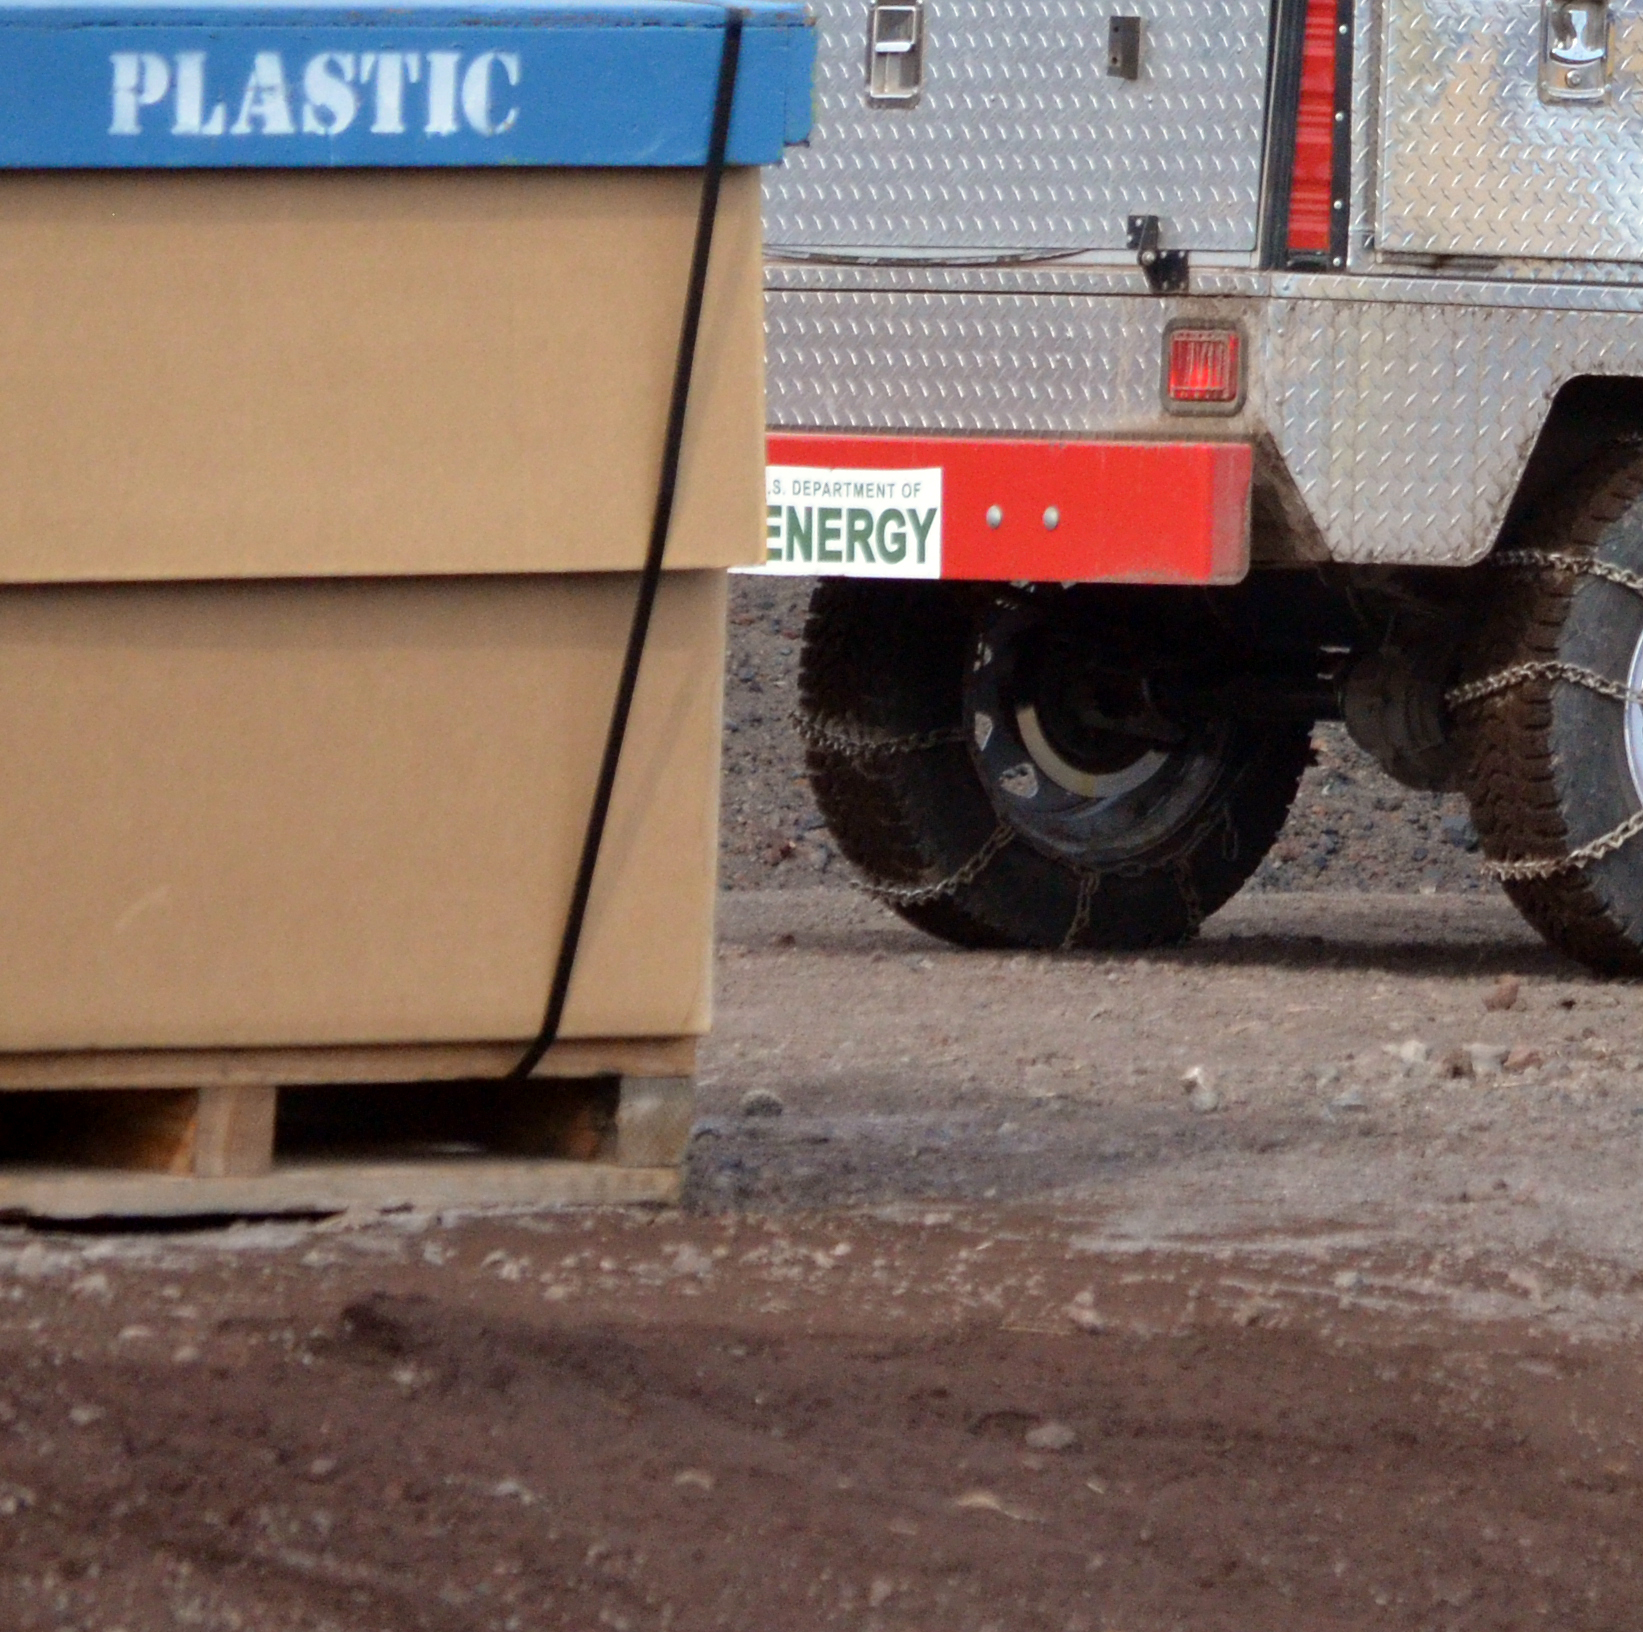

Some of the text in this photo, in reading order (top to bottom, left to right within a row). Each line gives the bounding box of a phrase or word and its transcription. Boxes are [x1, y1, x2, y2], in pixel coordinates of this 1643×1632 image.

[108, 51, 521, 136] PLASTIC
[792, 480, 895, 498] DEPARTMENT
[901, 483, 922, 498] OF
